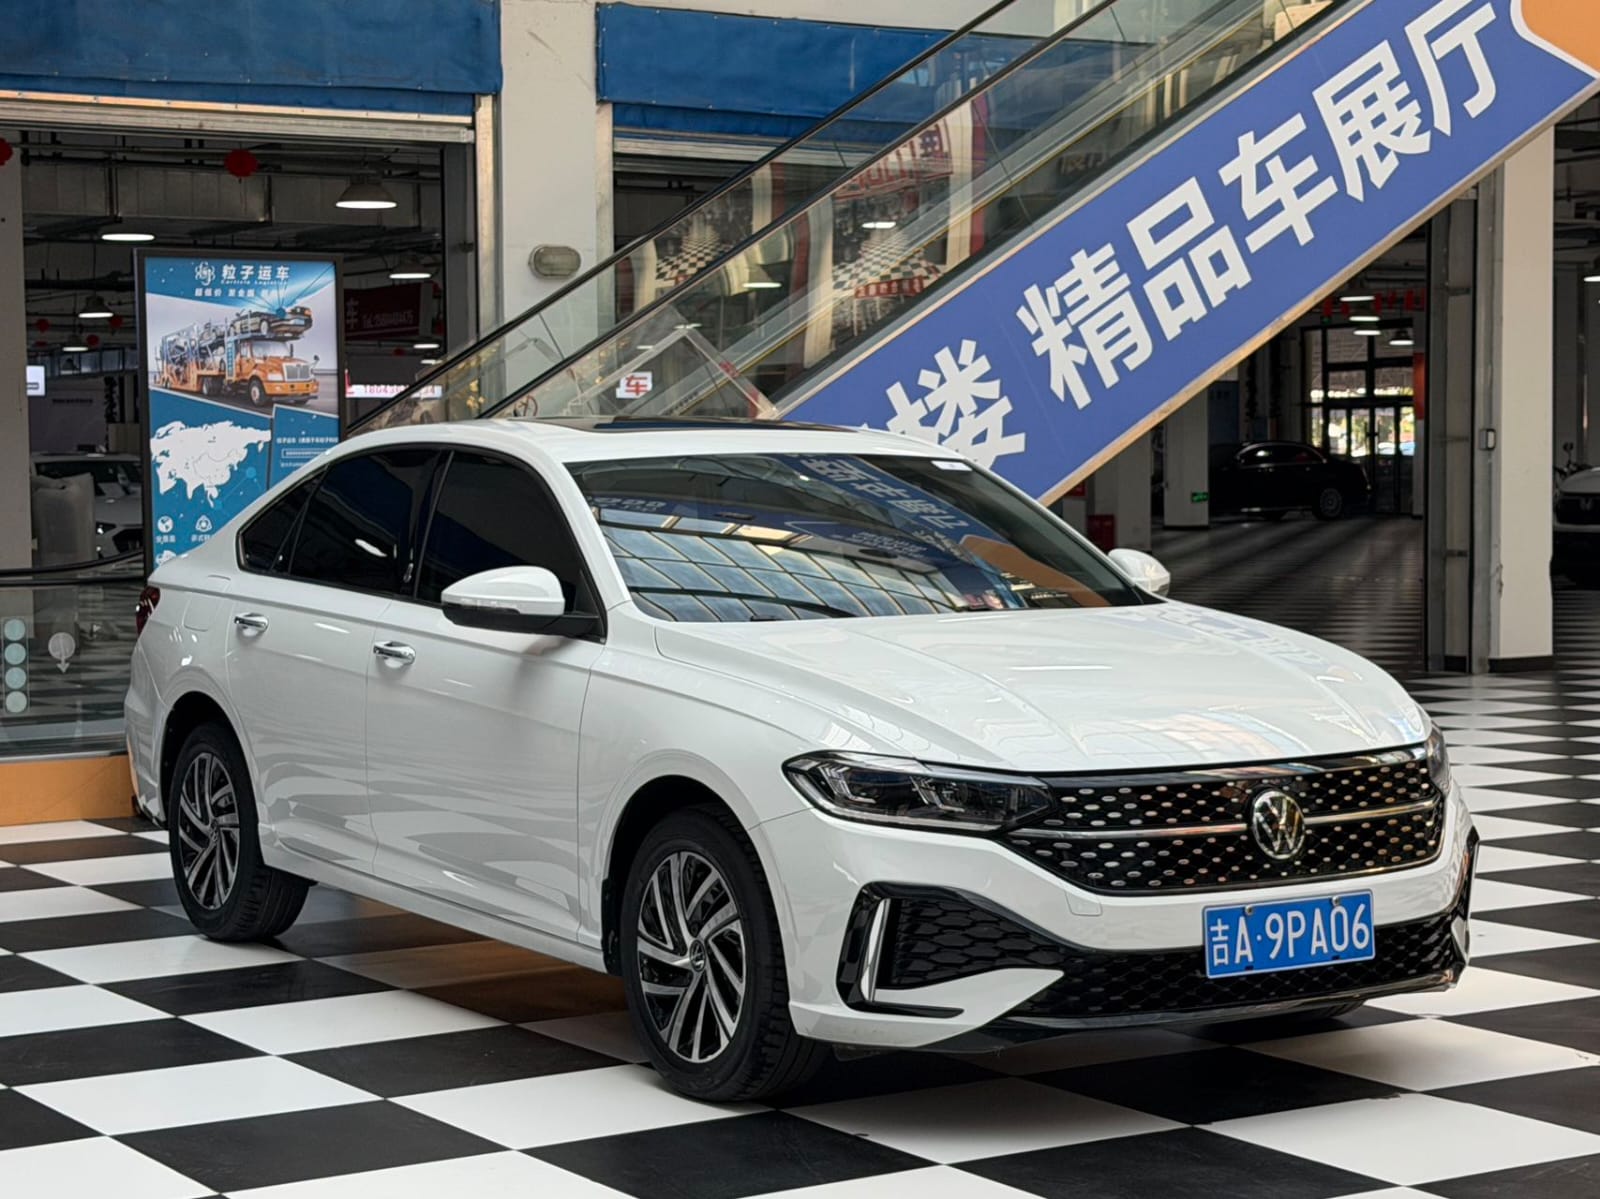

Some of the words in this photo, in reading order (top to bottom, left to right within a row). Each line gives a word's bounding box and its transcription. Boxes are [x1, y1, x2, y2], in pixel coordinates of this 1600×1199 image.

[222, 264, 290, 281] 粒子运车
[861, 339, 1026, 469] 楼
[1016, 0, 1496, 410] 精品车展厅
